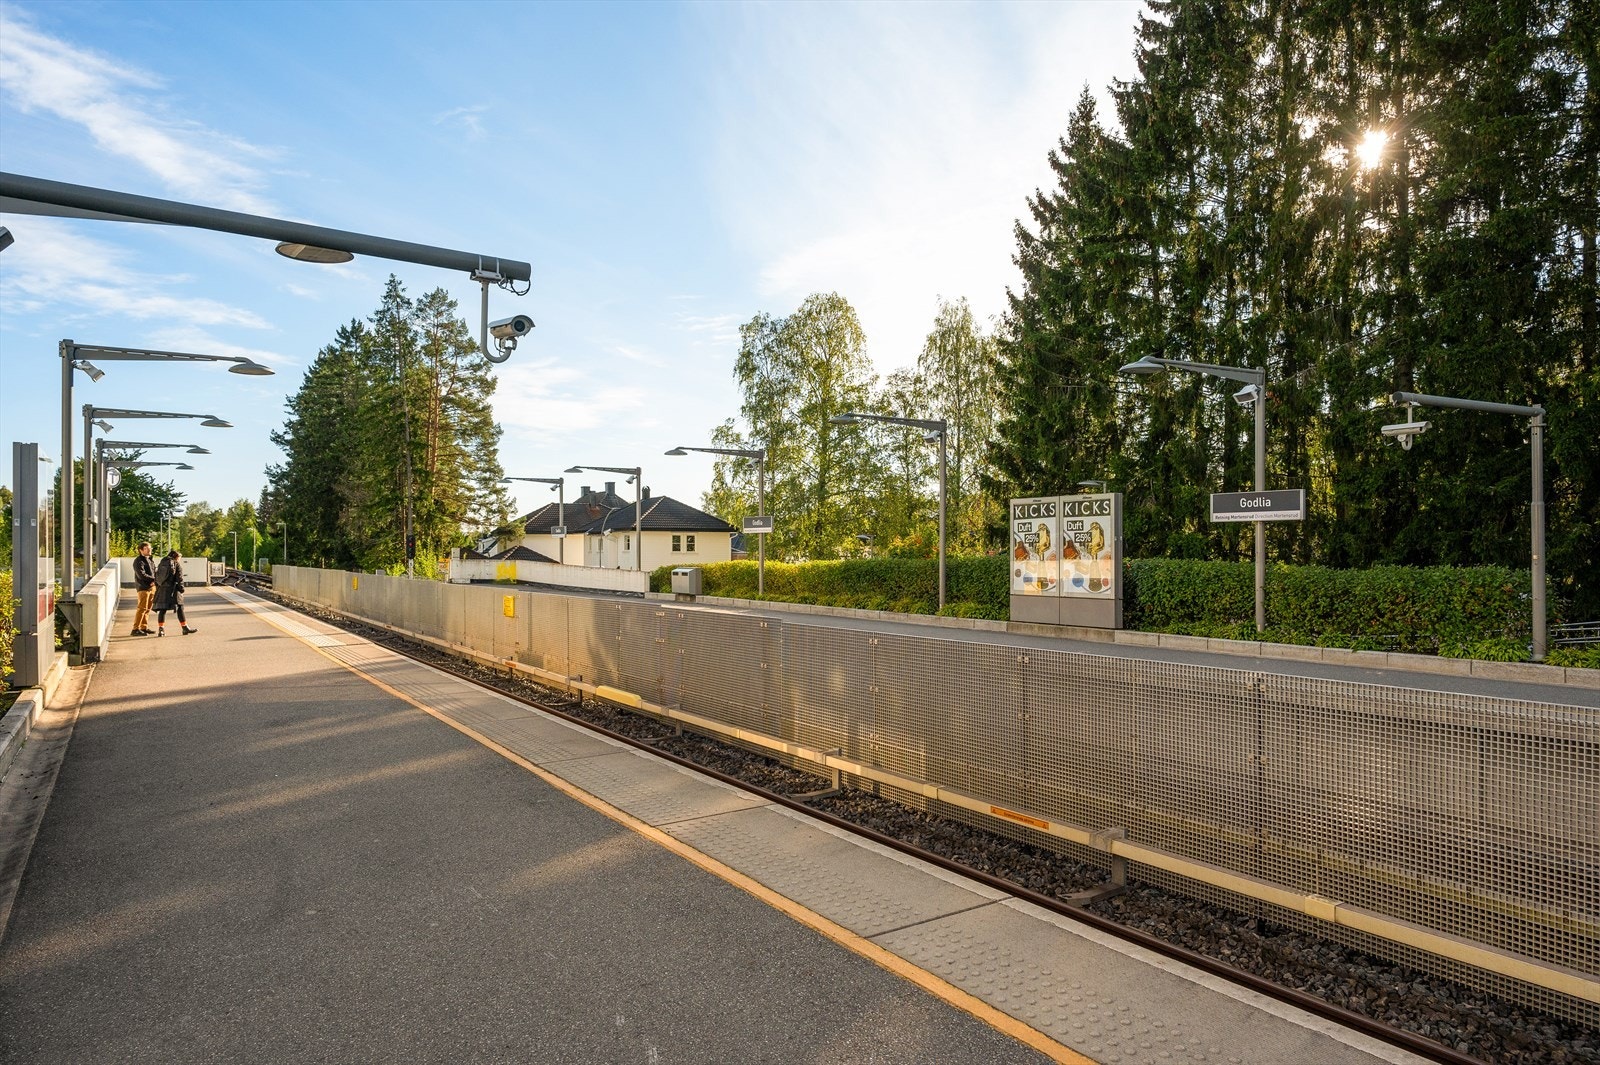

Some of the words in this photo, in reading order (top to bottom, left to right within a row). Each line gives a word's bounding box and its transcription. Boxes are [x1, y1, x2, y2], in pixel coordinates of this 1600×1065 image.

[1239, 497, 1271, 508] Godlia
[1015, 503, 1056, 518] KICKS
[1064, 501, 1110, 516] KICKS
[1019, 522, 1032, 531] Duft
[1067, 520, 1083, 530] Duft
[1025, 533, 1039, 543] 25%
[1075, 532, 1091, 542] 25%
